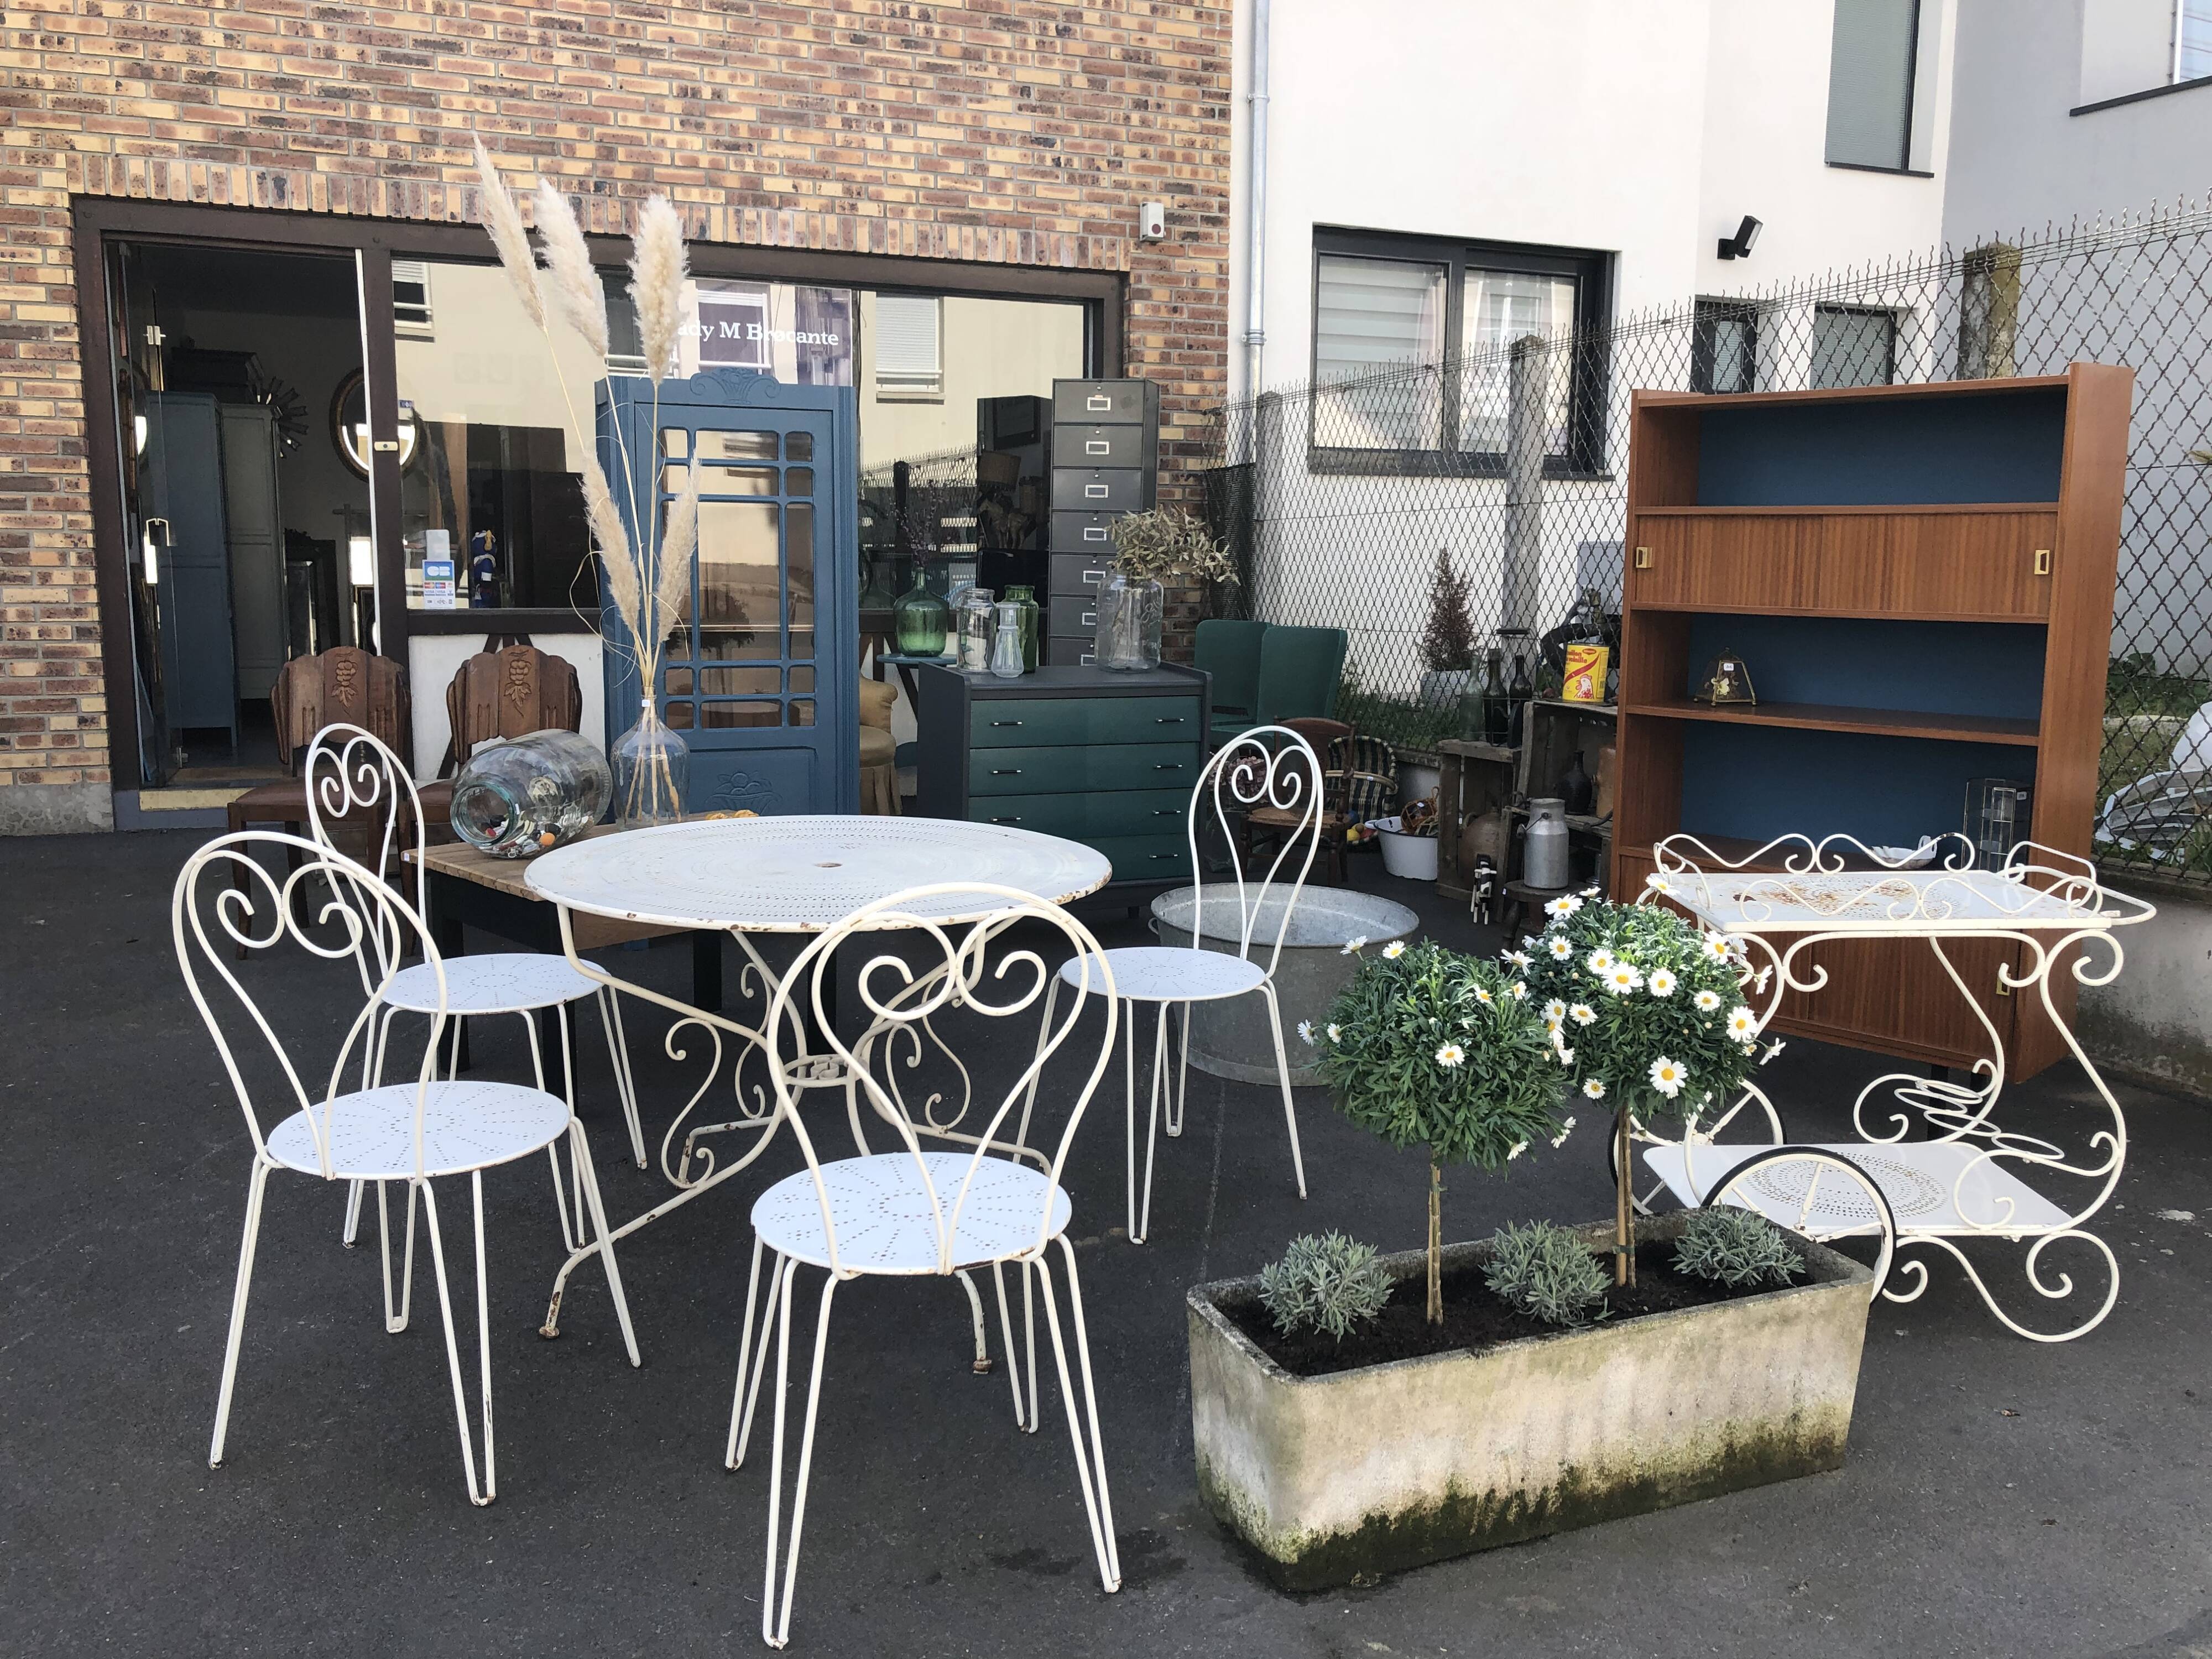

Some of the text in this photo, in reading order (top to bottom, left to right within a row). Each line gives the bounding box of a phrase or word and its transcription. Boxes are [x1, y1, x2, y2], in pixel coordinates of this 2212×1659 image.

[677, 320, 839, 346] ady M Brocante
